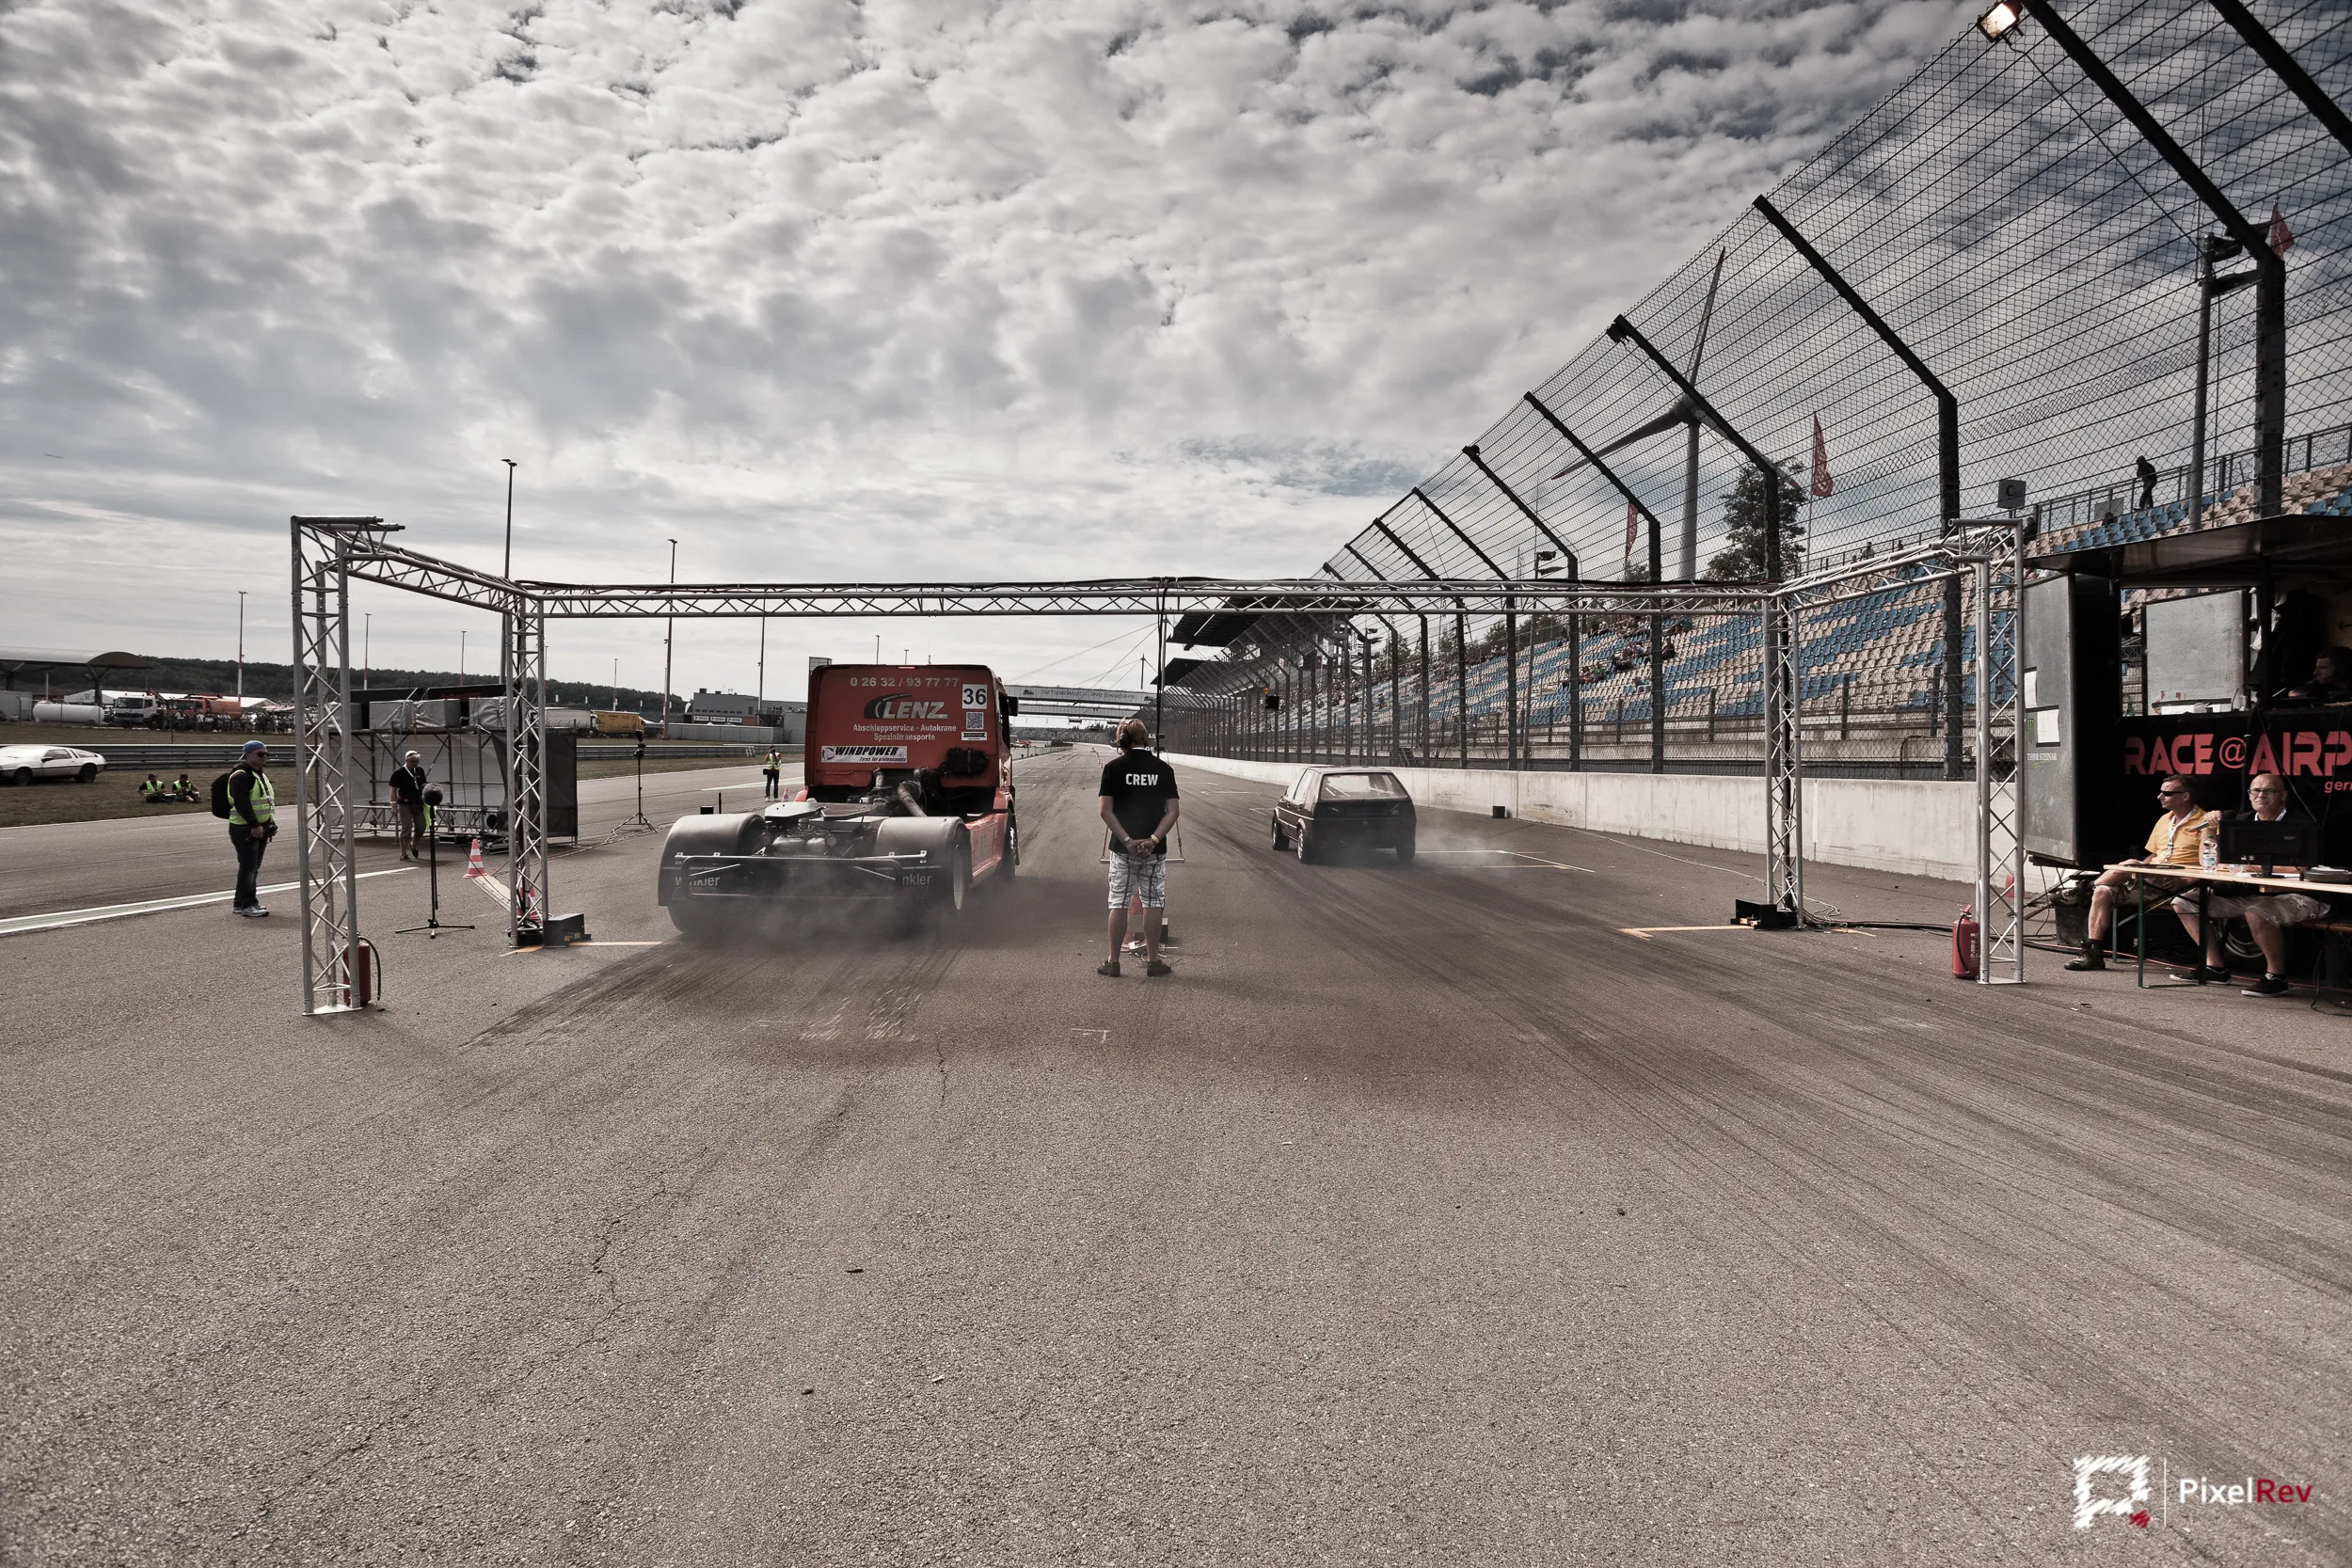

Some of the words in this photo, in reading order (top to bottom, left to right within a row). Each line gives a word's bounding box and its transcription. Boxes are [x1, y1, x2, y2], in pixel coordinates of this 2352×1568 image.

[850, 677, 858, 687] 0
[861, 677, 877, 687] 26
[881, 677, 896, 687] 32
[906, 677, 921, 687] 93
[926, 677, 941, 687] 77
[945, 677, 960, 687] 77
[962, 688, 987, 705] 36
[882, 701, 948, 720] LENZ
[853, 723, 914, 733] Abschleppservice
[920, 723, 957, 732] Autokrane
[874, 733, 935, 741] Spezialtransporte
[835, 746, 898, 755] WINDPOWER
[1124, 773, 1158, 786] CREW
[2324, 781, 2352, 794] ger
[675, 875, 721, 886] wkler
